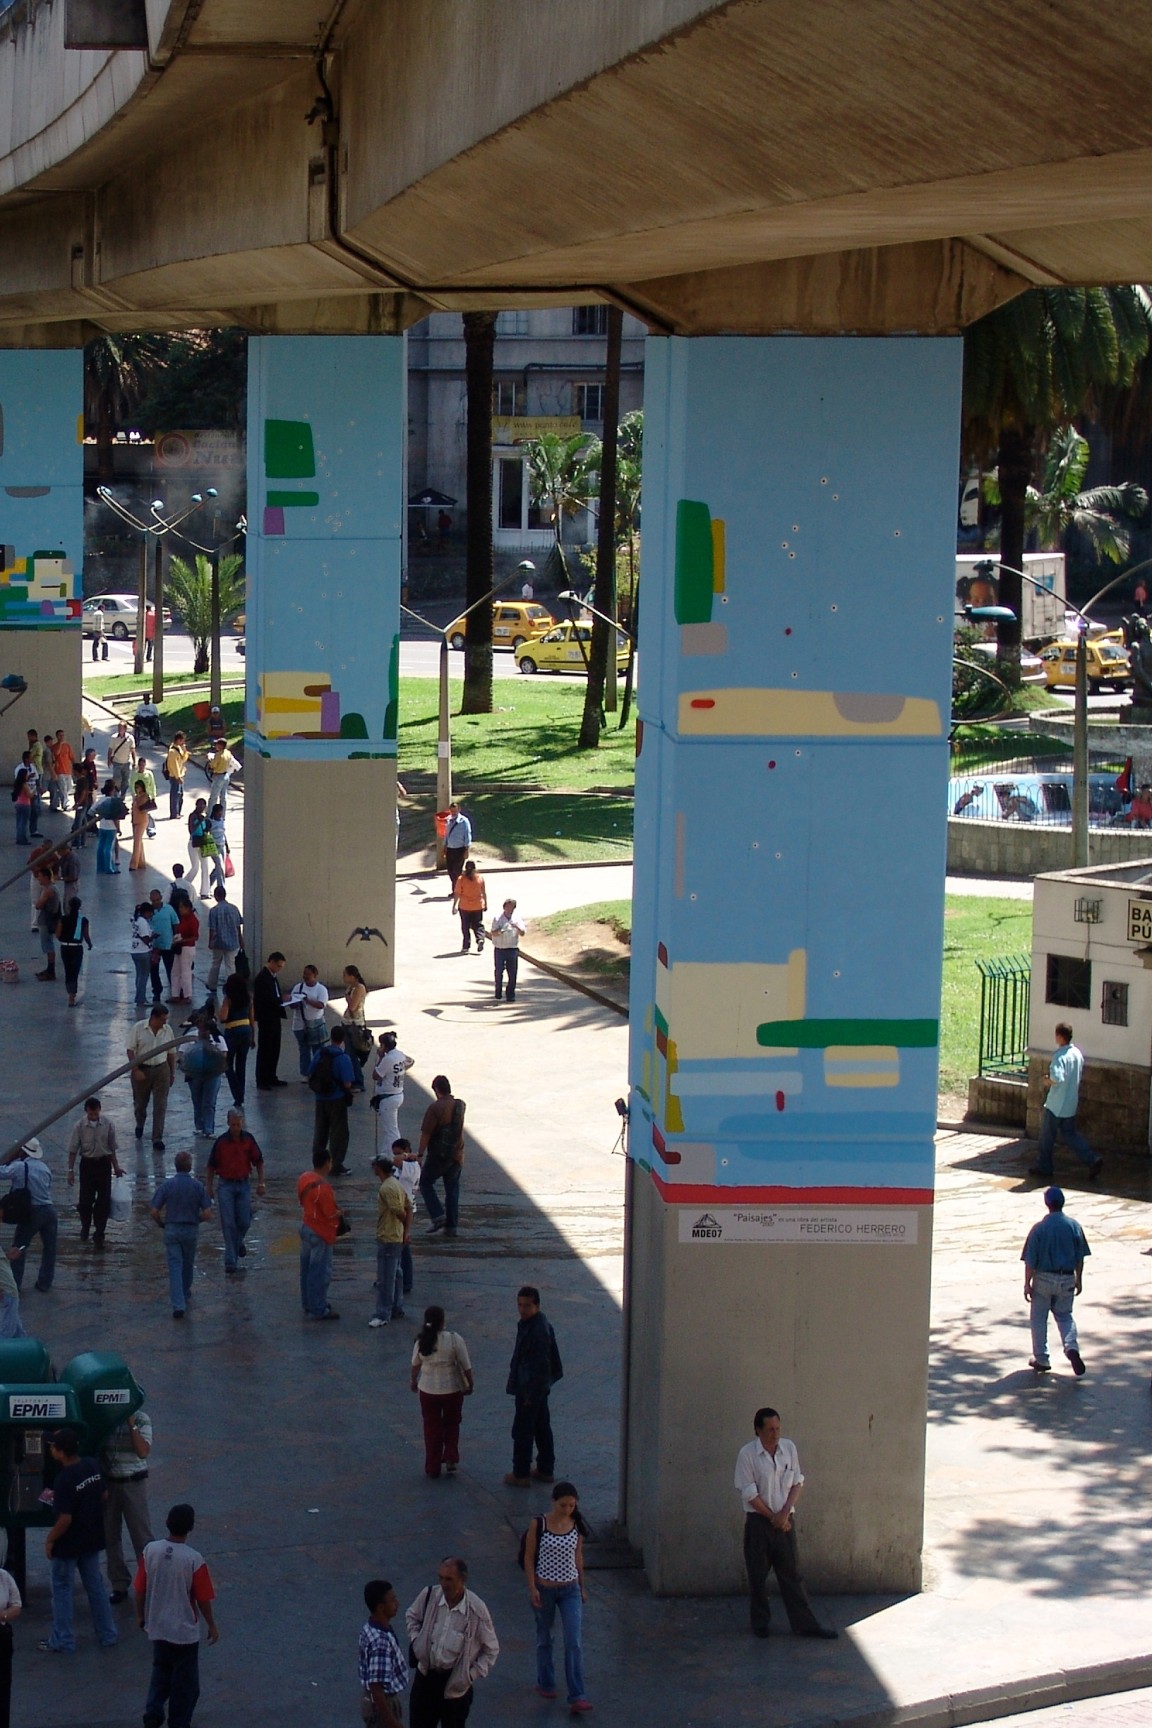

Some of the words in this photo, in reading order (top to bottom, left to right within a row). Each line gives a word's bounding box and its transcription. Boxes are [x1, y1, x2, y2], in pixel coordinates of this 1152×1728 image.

[692, 1229, 722, 1238] MDE07
[800, 1224, 852, 1234] FEDERICO
[856, 1225, 906, 1234] HERRERO
[96, 1393, 119, 1402] EPM
[12, 1403, 49, 1417] EPM
